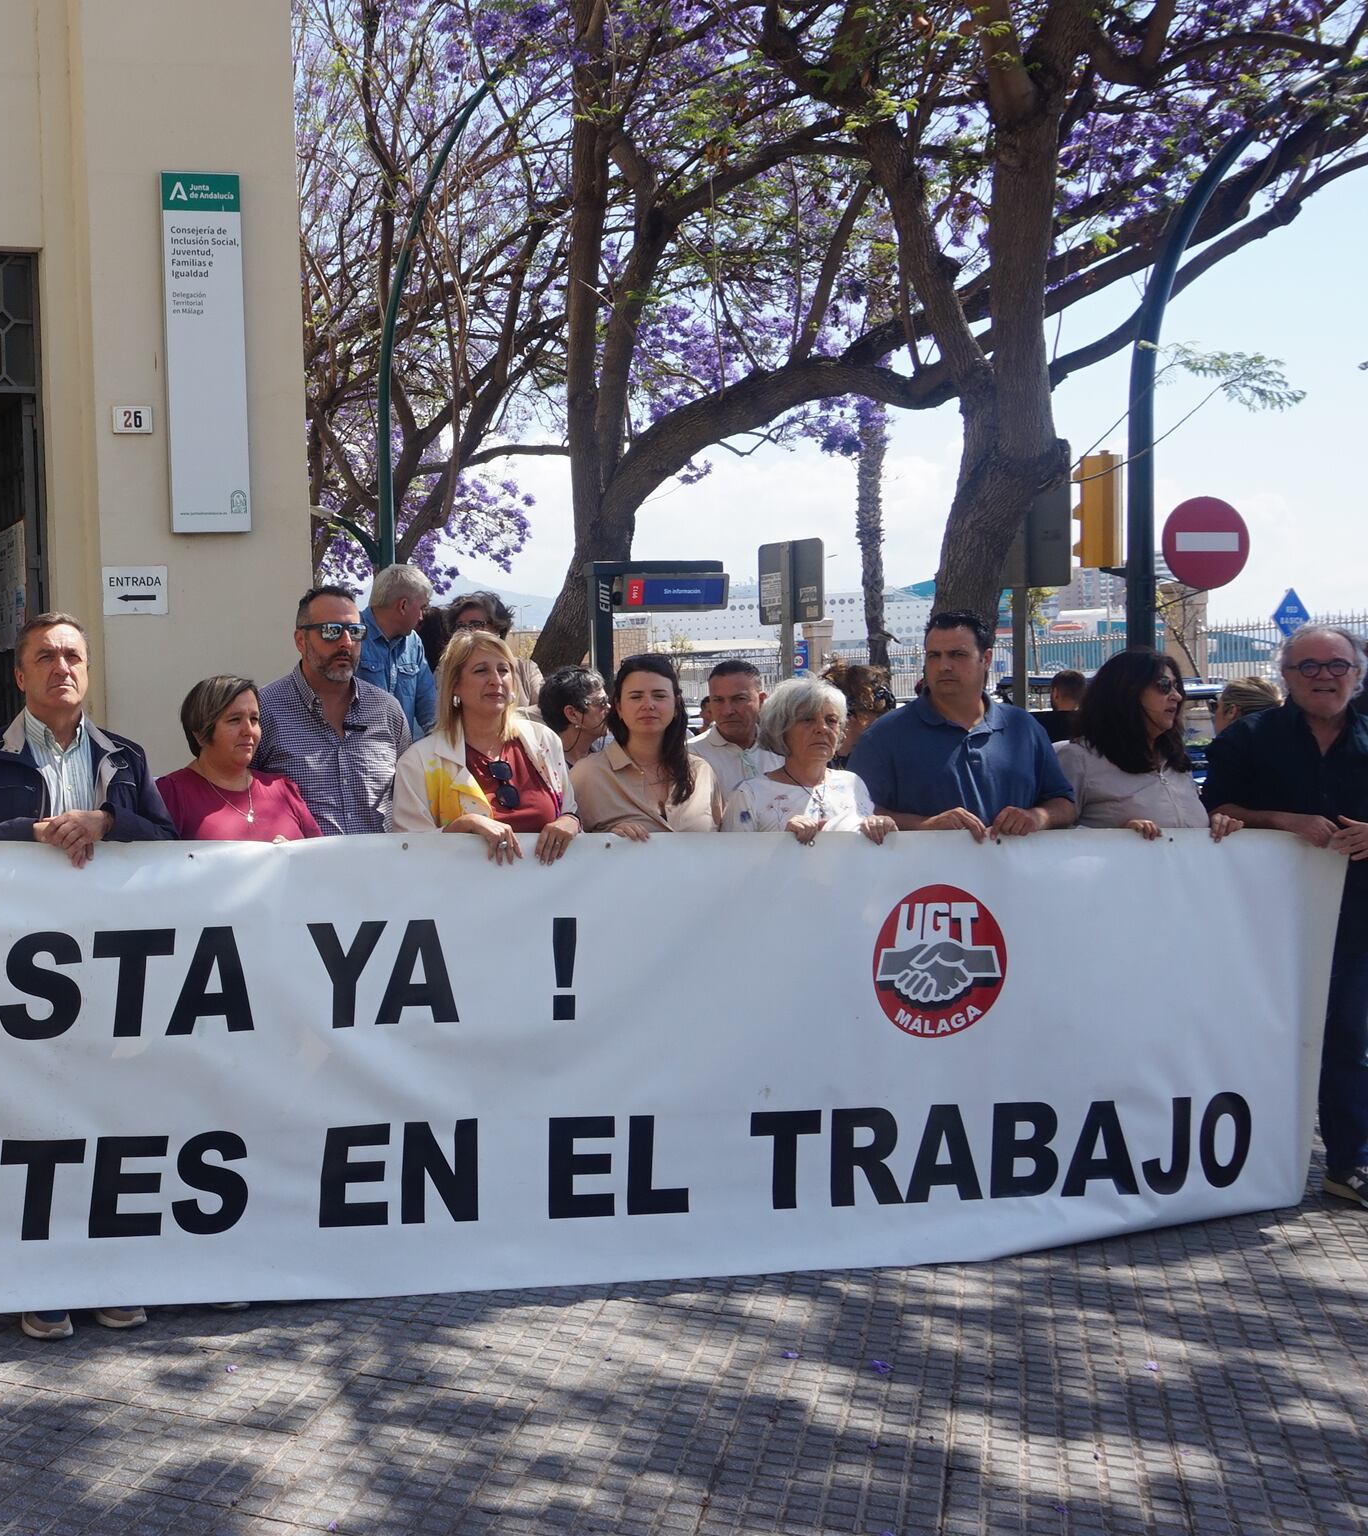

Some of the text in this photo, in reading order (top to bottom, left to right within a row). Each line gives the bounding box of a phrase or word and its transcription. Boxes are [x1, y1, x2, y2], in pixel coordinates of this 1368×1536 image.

[199, 192, 234, 200] Andalucía
[170, 226, 227, 236] Consejería de
[171, 236, 239, 247] Inclusión Social,
[172, 248, 214, 257] Juventud,
[172, 258, 207, 267] Familias
[172, 269, 209, 279] Igualdad
[172, 291, 207, 299] Delegación
[123, 410, 143, 429] 26
[108, 576, 162, 587] ENTRADA
[894, 901, 980, 950] UGT
[306, 919, 460, 1029] YA
[552, 917, 577, 1021] !
[894, 1004, 983, 1035] MÁLAGA
[318, 1117, 479, 1228] EN
[548, 1115, 690, 1220] EL
[750, 1091, 1252, 1210] TRABAJO
